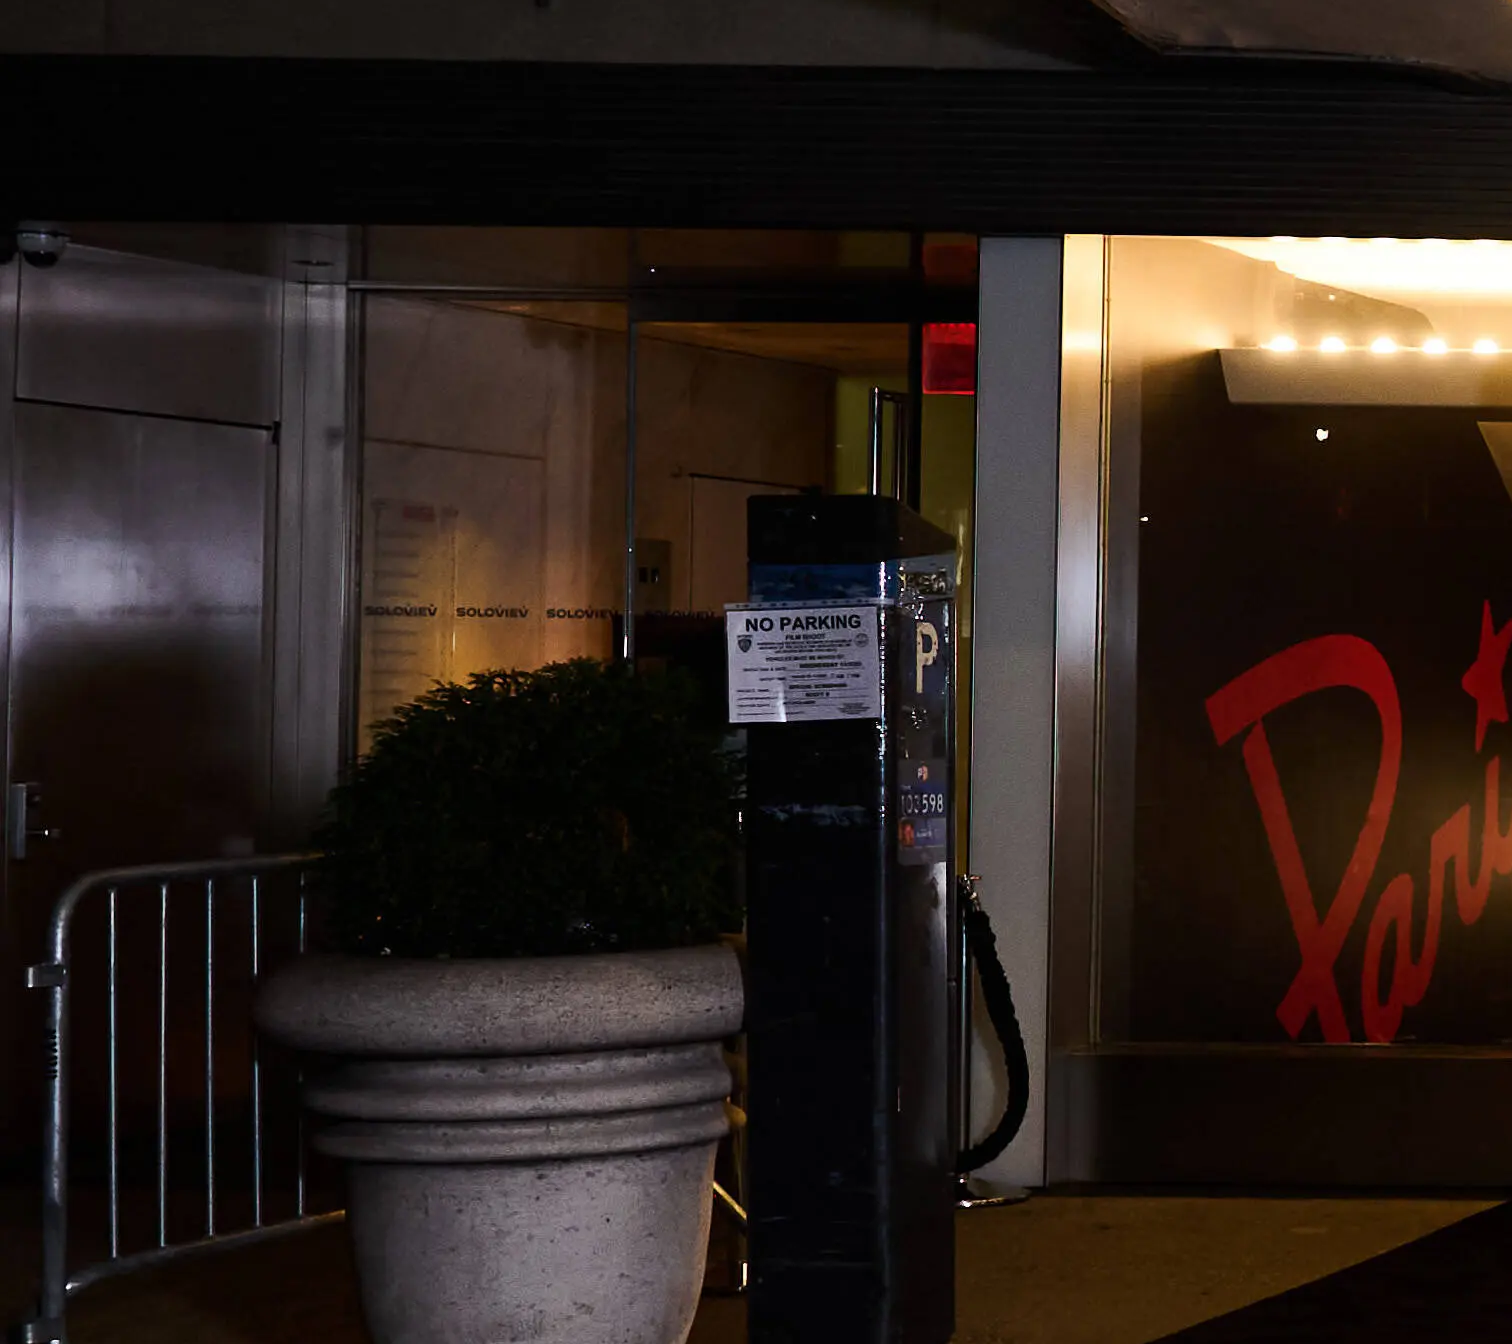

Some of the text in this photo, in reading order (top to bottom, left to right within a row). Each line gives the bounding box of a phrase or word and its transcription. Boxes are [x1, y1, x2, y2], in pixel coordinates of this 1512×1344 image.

[456, 604, 529, 619] SOLOVIEV
[745, 614, 861, 632] NO PARKING
[915, 621, 939, 694] P
